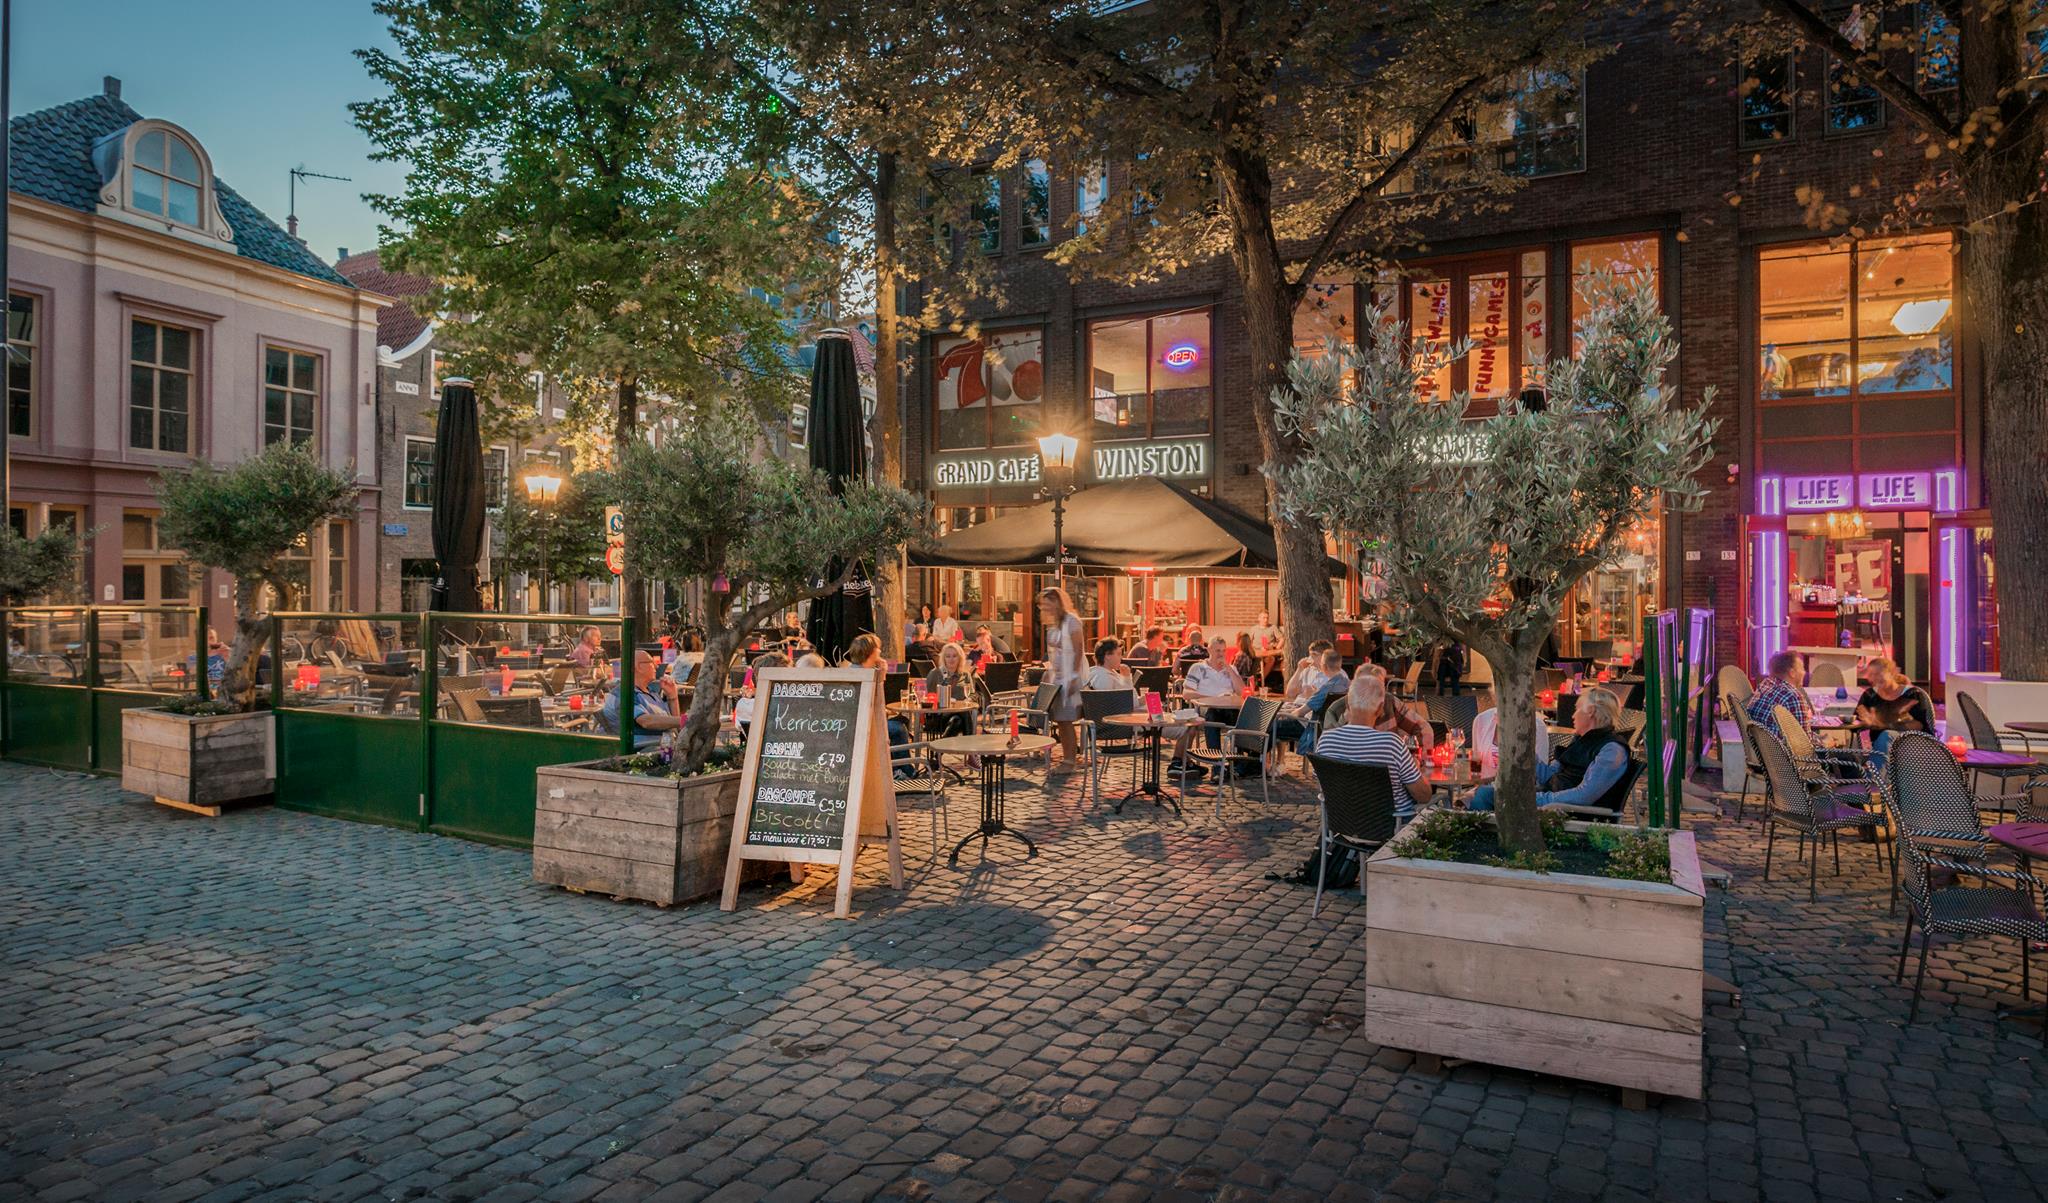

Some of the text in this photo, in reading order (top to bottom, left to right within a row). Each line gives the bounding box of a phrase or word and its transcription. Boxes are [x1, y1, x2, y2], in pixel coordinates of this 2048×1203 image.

[1167, 351, 1196, 363] OPEN
[398, 384, 417, 392] ANNO
[935, 453, 1040, 485] GRAND CAFÉ
[1094, 444, 1203, 478] WINSTON
[1798, 480, 1839, 499] LIFE
[1872, 477, 1915, 497] LIFE
[1046, 555, 1077, 564] Heeken
[1836, 600, 1890, 616] ND MORE
[774, 703, 848, 740] Kerriesoep
[764, 742, 805, 757] DAGHAP
[757, 787, 816, 804] DAGCOUPE
[755, 809, 835, 830] Biscotti
[749, 834, 761, 842] als
[763, 835, 782, 843] menu
